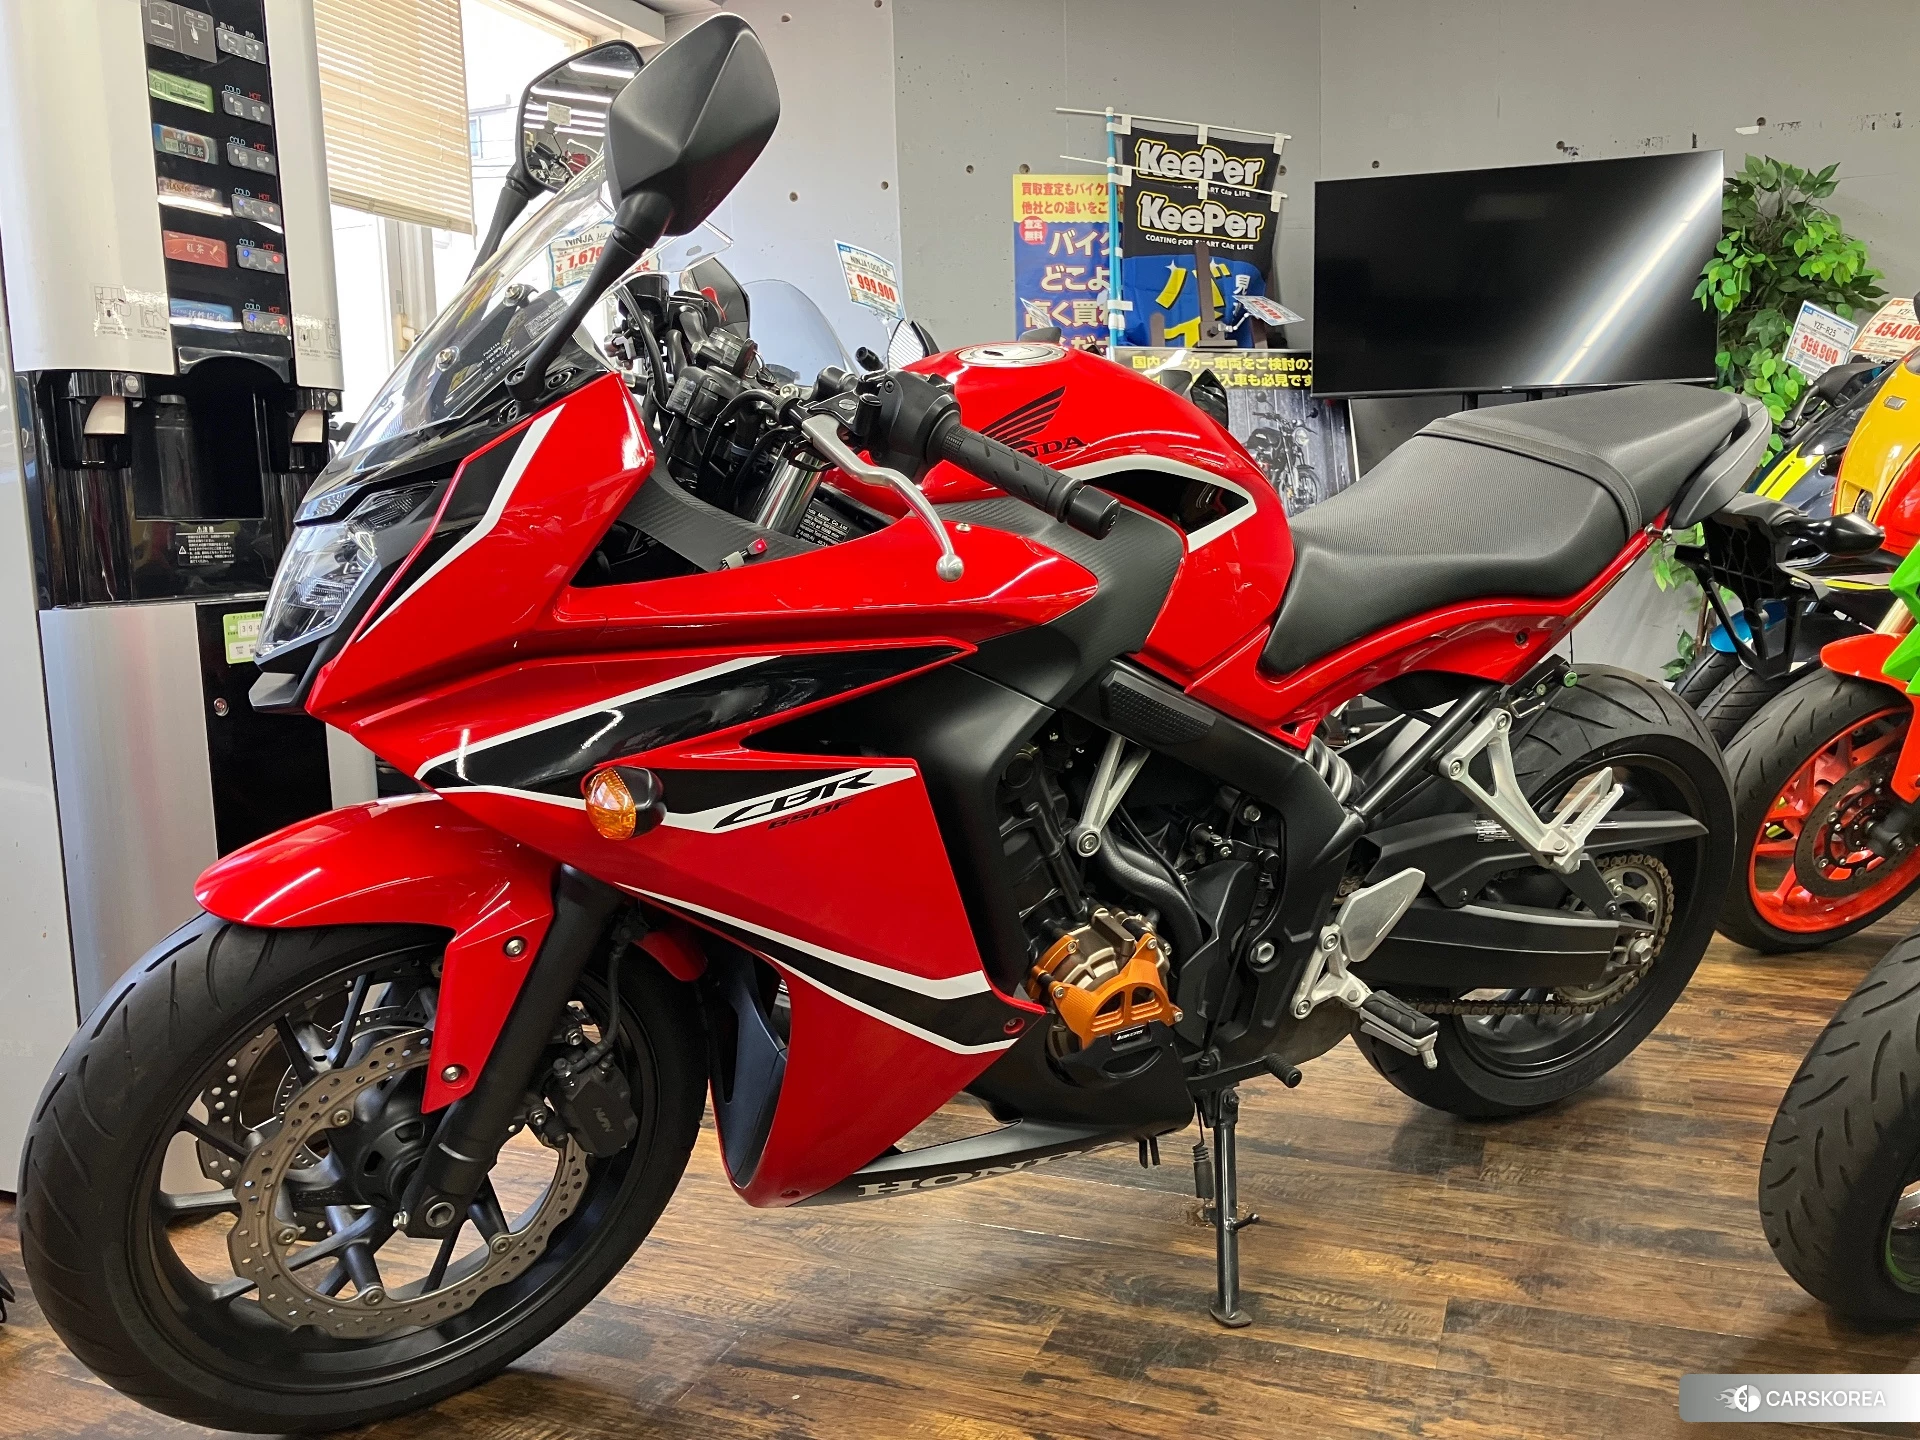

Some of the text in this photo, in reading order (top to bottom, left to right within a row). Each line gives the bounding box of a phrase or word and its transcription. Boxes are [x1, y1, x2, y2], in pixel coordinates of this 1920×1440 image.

[224, 84, 261, 101] COLD HOT
[229, 135, 266, 151] COLD HOT
[1137, 140, 1263, 186] KeePer
[234, 187, 270, 202] COLD HOT
[1021, 183, 1124, 196] 買取査定もバイク
[1234, 189, 1251, 198] LIFE
[1139, 193, 1264, 239] KeePer
[238, 238, 275, 251] COLD HOT
[1145, 233, 1178, 246] COATING
[1178, 238, 1194, 247] FOR
[1221, 242, 1235, 251] CAR
[1236, 243, 1254, 251] LIFE
[856, 273, 896, 303] 999,900
[244, 302, 280, 313] COLD HOT
[1813, 320, 1837, 338] YZF-R25
[1018, 435, 1087, 459] NDA
[712, 769, 878, 830] CBR
[766, 798, 857, 831] 650F
